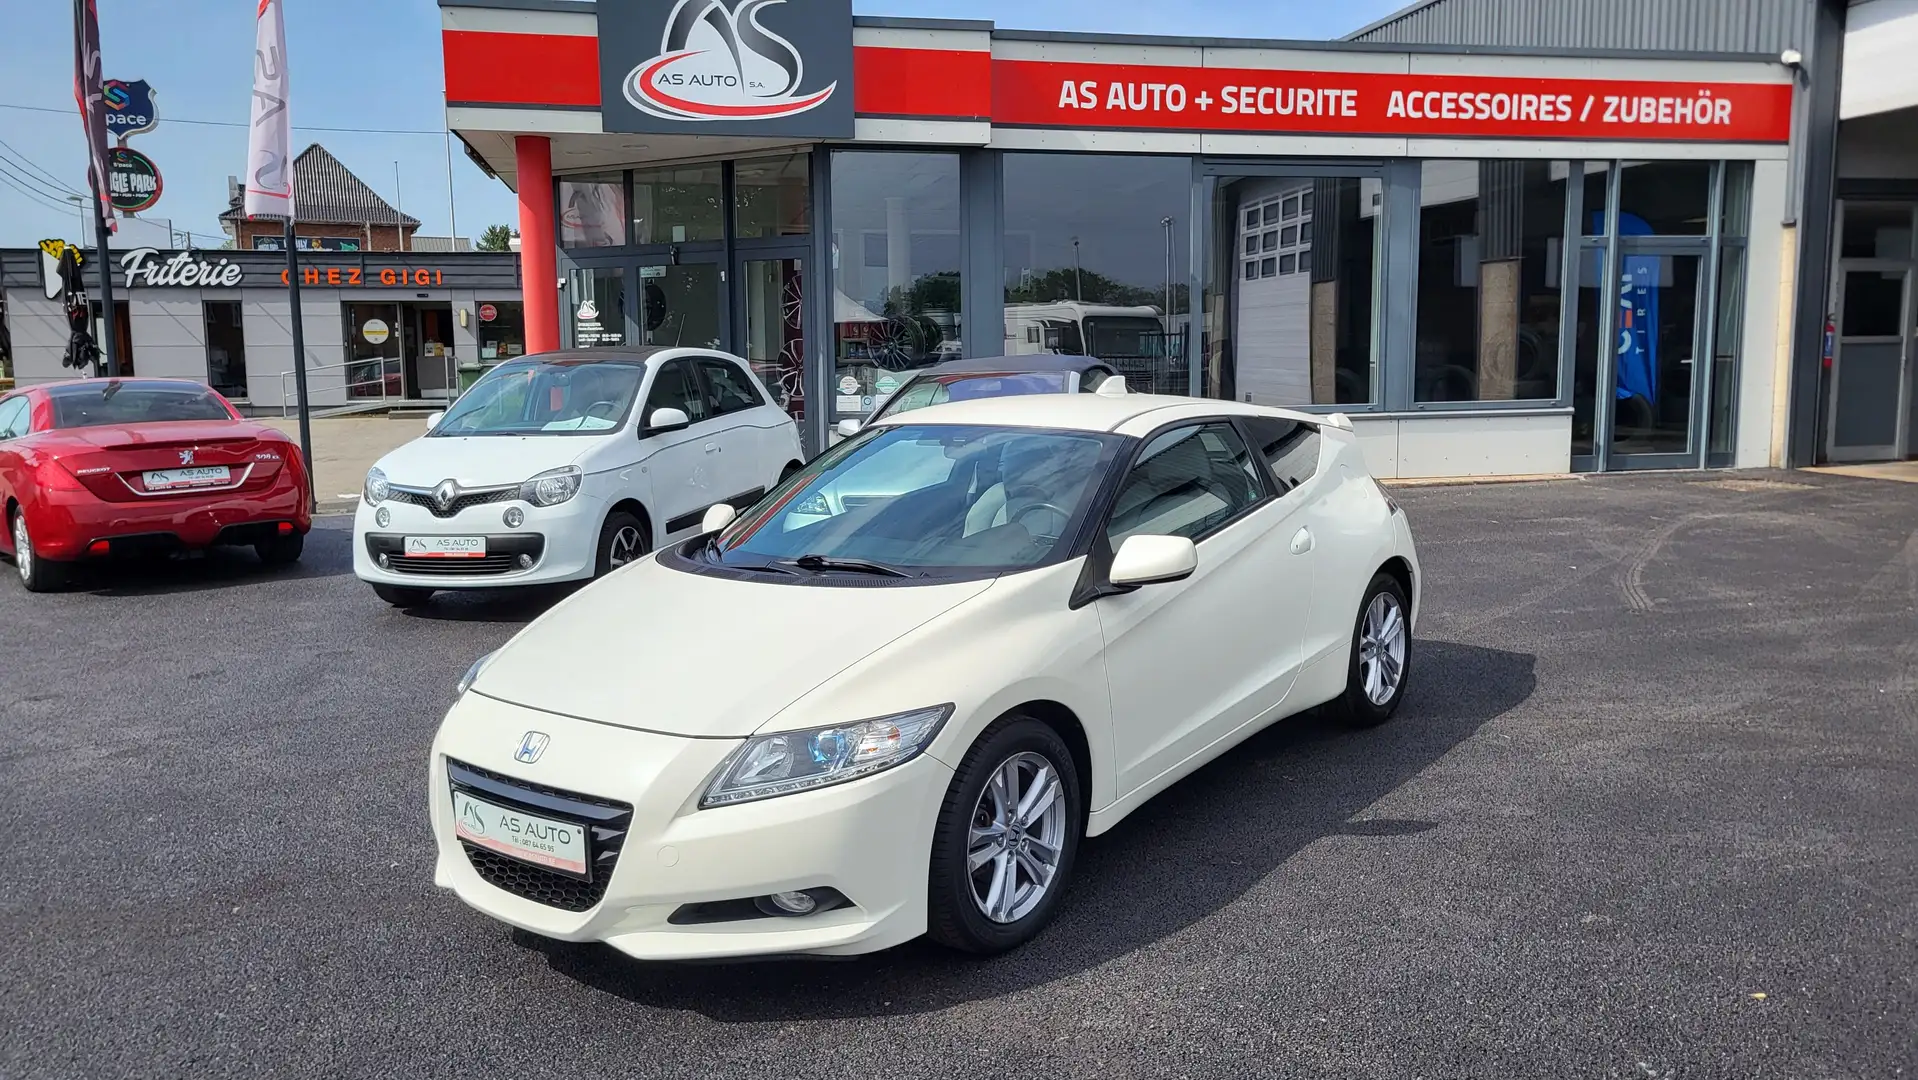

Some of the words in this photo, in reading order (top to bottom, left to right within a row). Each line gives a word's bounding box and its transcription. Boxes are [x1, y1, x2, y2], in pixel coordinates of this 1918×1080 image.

[657, 73, 684, 85] AS
[688, 74, 737, 87] AUTO
[749, 81, 766, 89] S.A.
[1058, 80, 1097, 109] AS
[1106, 82, 1187, 112] AUTO
[1221, 85, 1358, 117] SECURITE
[1386, 90, 1572, 122] ACCESSOIRES
[1602, 89, 1732, 125] ZUBEHÖR
[130, 173, 157, 193] PARK
[120, 247, 243, 288] Friterie
[380, 268, 443, 286] GIGI
[1635, 266, 1648, 355] TIRES
[196, 467, 223, 475] AUTO
[499, 814, 521, 833] AS
[524, 822, 571, 845] AUTO
